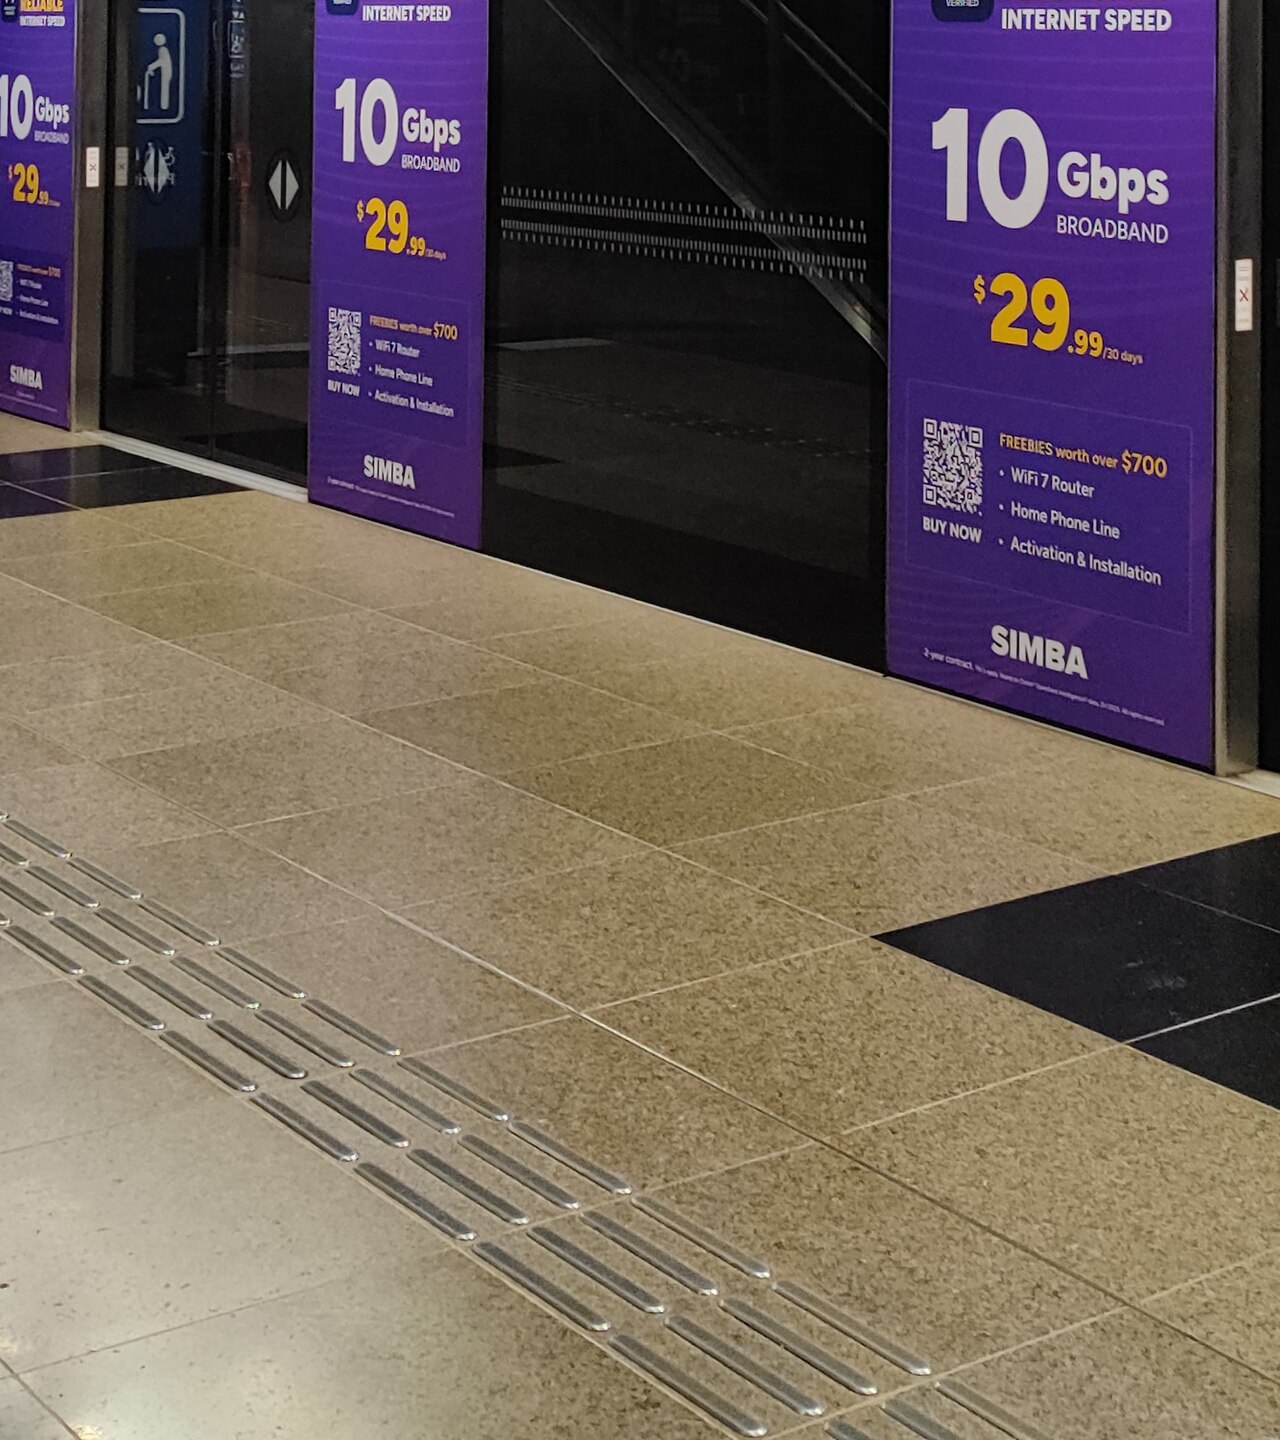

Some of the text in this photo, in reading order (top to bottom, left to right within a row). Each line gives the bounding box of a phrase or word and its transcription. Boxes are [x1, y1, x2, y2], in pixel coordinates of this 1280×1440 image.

[362, 5, 451, 21] INTERNET SPEED
[1001, 8, 1173, 32] INTERNET SPEED
[35, 96, 69, 130] Gbps
[335, 77, 461, 166] 10 Gbps
[401, 154, 461, 173] BROADBAND
[931, 107, 1170, 229] 10 Gbps
[1056, 213, 1169, 244] BROADBAND
[433, 321, 458, 341] $700
[374, 364, 395, 380] Home
[1120, 349, 1144, 365] days
[9, 364, 43, 390] SIMBA
[327, 379, 360, 397] BUY NOW
[375, 389, 409, 408] Activation
[999, 433, 1168, 478] FREEBIES worth over $700
[363, 454, 416, 490] SIMBA
[1010, 466, 1095, 499] WiFi 7 Router
[923, 515, 982, 544] BUY NOW
[1010, 500, 1120, 540] Home Phone Line
[1010, 536, 1162, 586] Activation & Installation
[990, 624, 1089, 680] SIMBA
